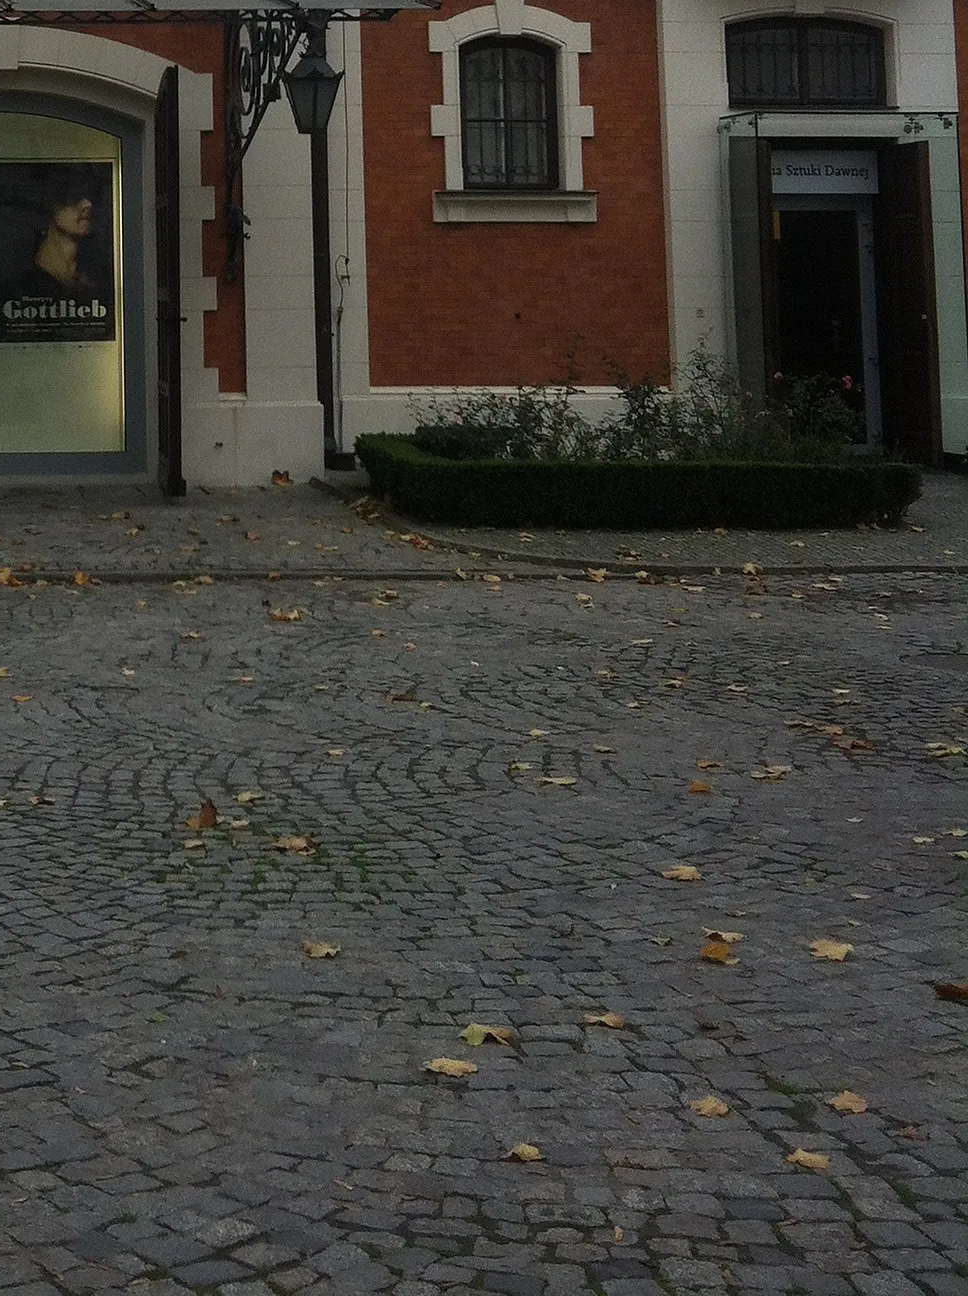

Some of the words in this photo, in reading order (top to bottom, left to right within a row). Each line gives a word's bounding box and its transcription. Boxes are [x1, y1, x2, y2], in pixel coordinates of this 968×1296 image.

[786, 164, 821, 177] Sztuki
[824, 164, 869, 180] Dawnej
[3, 299, 107, 319] Gottlieb
